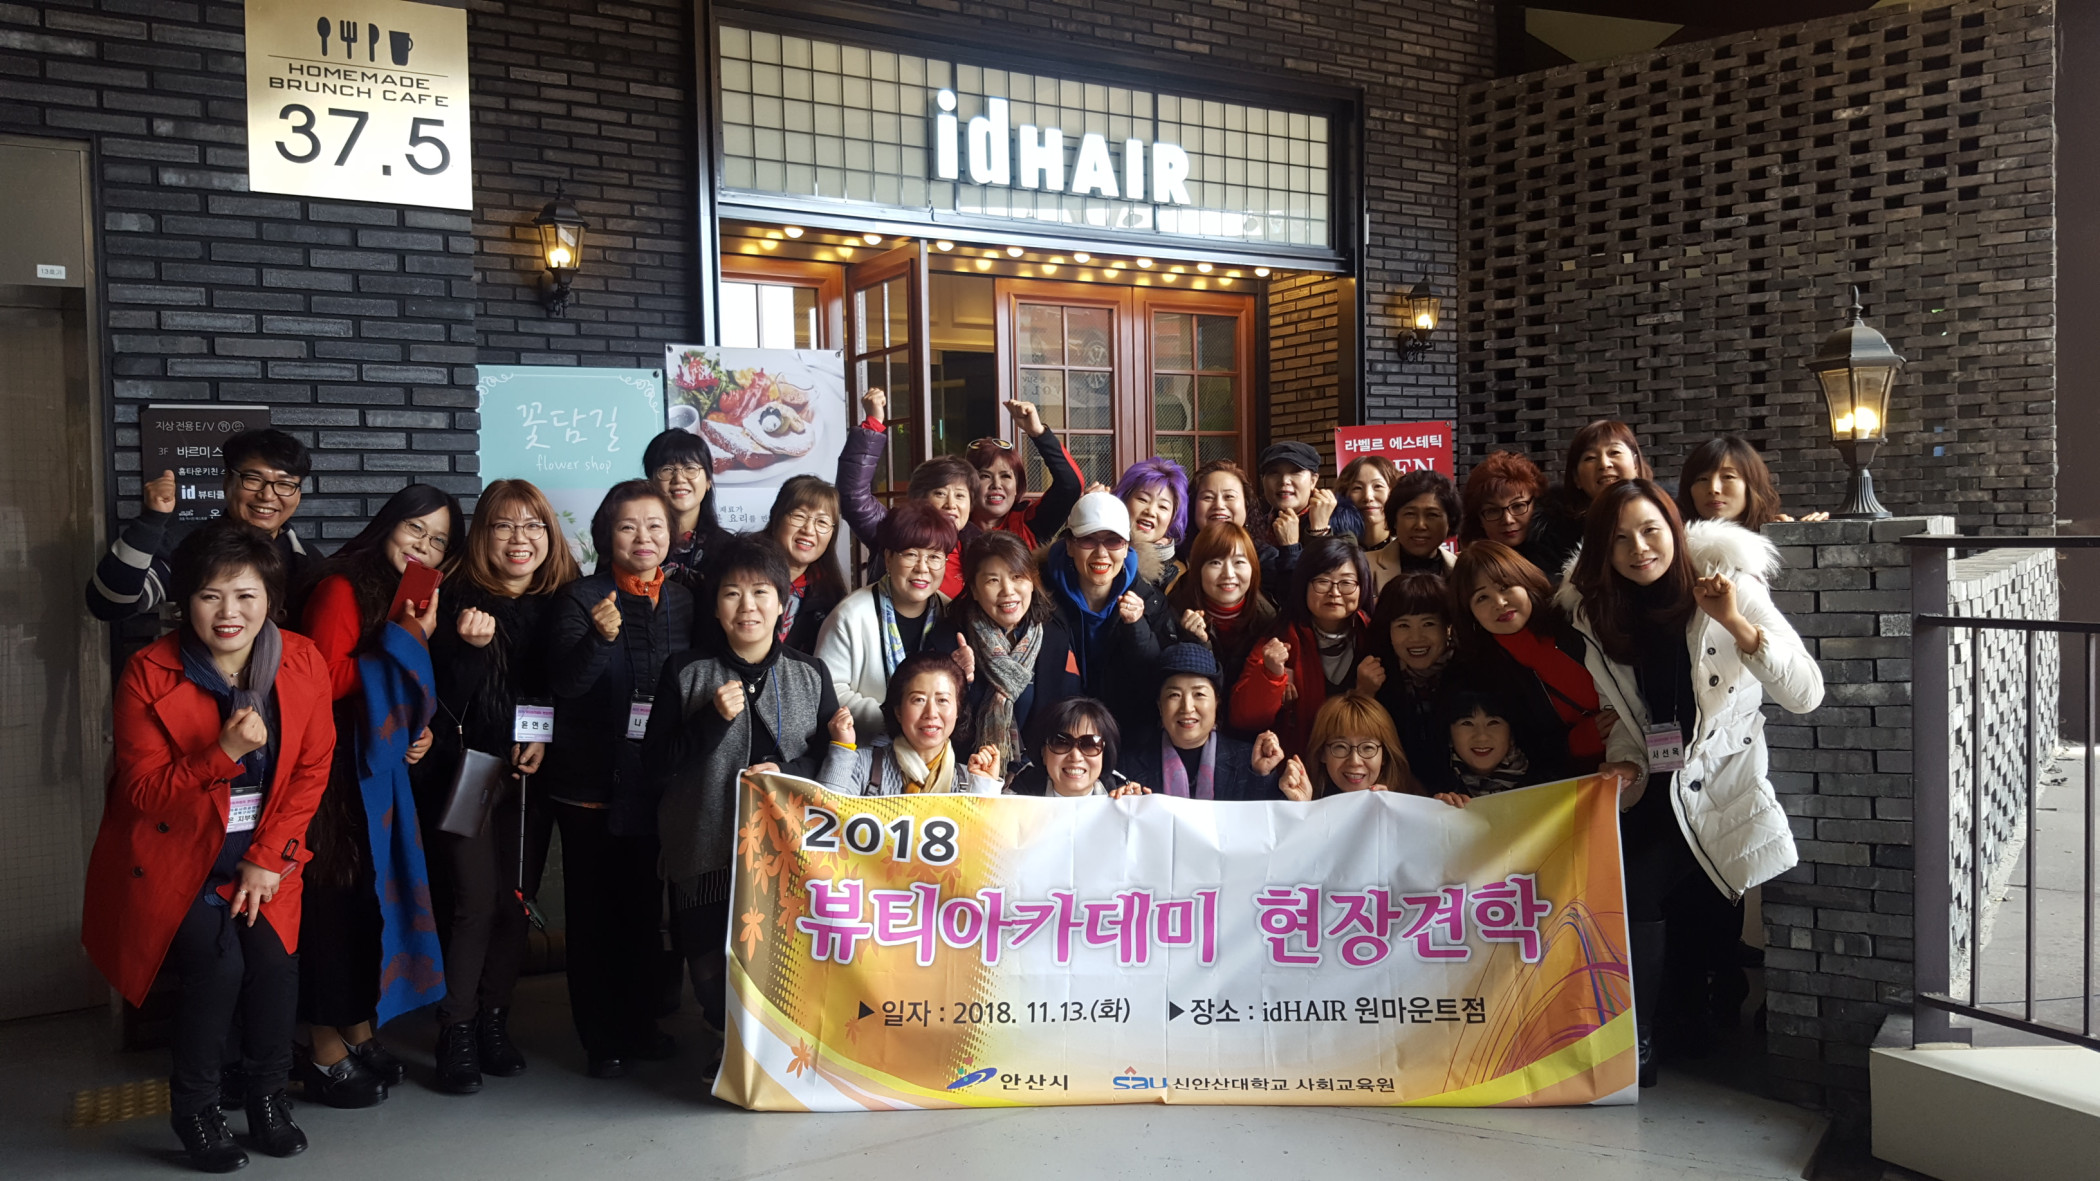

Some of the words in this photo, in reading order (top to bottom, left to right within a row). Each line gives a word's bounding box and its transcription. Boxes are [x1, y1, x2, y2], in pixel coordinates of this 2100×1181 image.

[288, 62, 430, 90] HOMEMADE
[269, 77, 372, 99] BRUNCH
[382, 90, 449, 108] CAFE
[274, 103, 451, 176] 37.5
[936, 88, 1192, 206] idHAIR
[516, 401, 621, 452] 꽃담길
[211, 446, 224, 457] 스
[1344, 438, 1384, 452] 라벨르
[1389, 434, 1442, 450] 에스테틱
[535, 454, 579, 472] flower
[584, 459, 612, 474] shop
[181, 485, 196, 500] id
[198, 490, 225, 499] 뷰티클
[802, 806, 959, 866] 2018
[796, 878, 1221, 967] 뷰티아카데미
[1252, 873, 1552, 969] 현장견학
[881, 1000, 932, 1028] 일자
[952, 1001, 1017, 1025] 2018.
[1189, 998, 1241, 1026] 장소
[1261, 999, 1348, 1023] idHAIR
[1354, 996, 1486, 1024] 원마운트점
[1000, 1072, 1069, 1091] 안산시
[1173, 1076, 1290, 1092] 신안산대학교
[1295, 1076, 1396, 1093] 사회교육원
